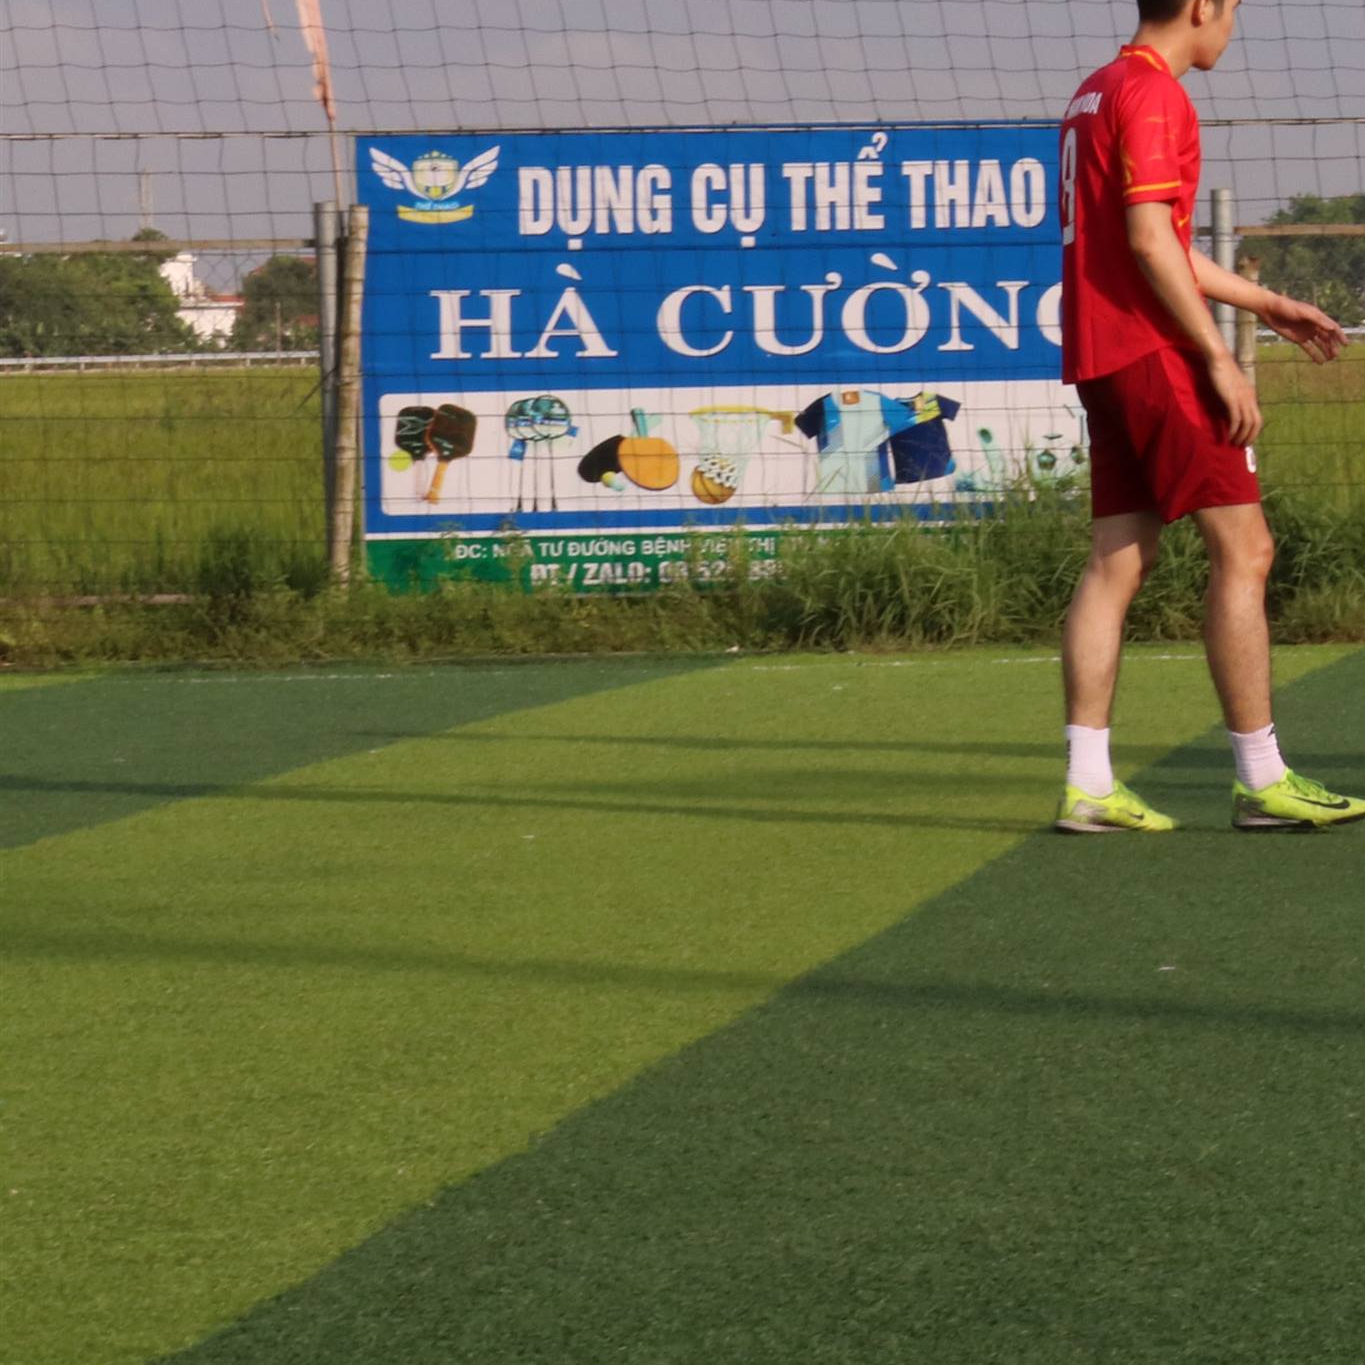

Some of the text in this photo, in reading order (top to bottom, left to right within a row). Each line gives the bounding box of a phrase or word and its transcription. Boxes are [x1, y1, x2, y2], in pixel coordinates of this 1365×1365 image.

[518, 132, 1046, 250] DỤNG CỤ THỂ THAO
[430, 263, 619, 359] HÀ
